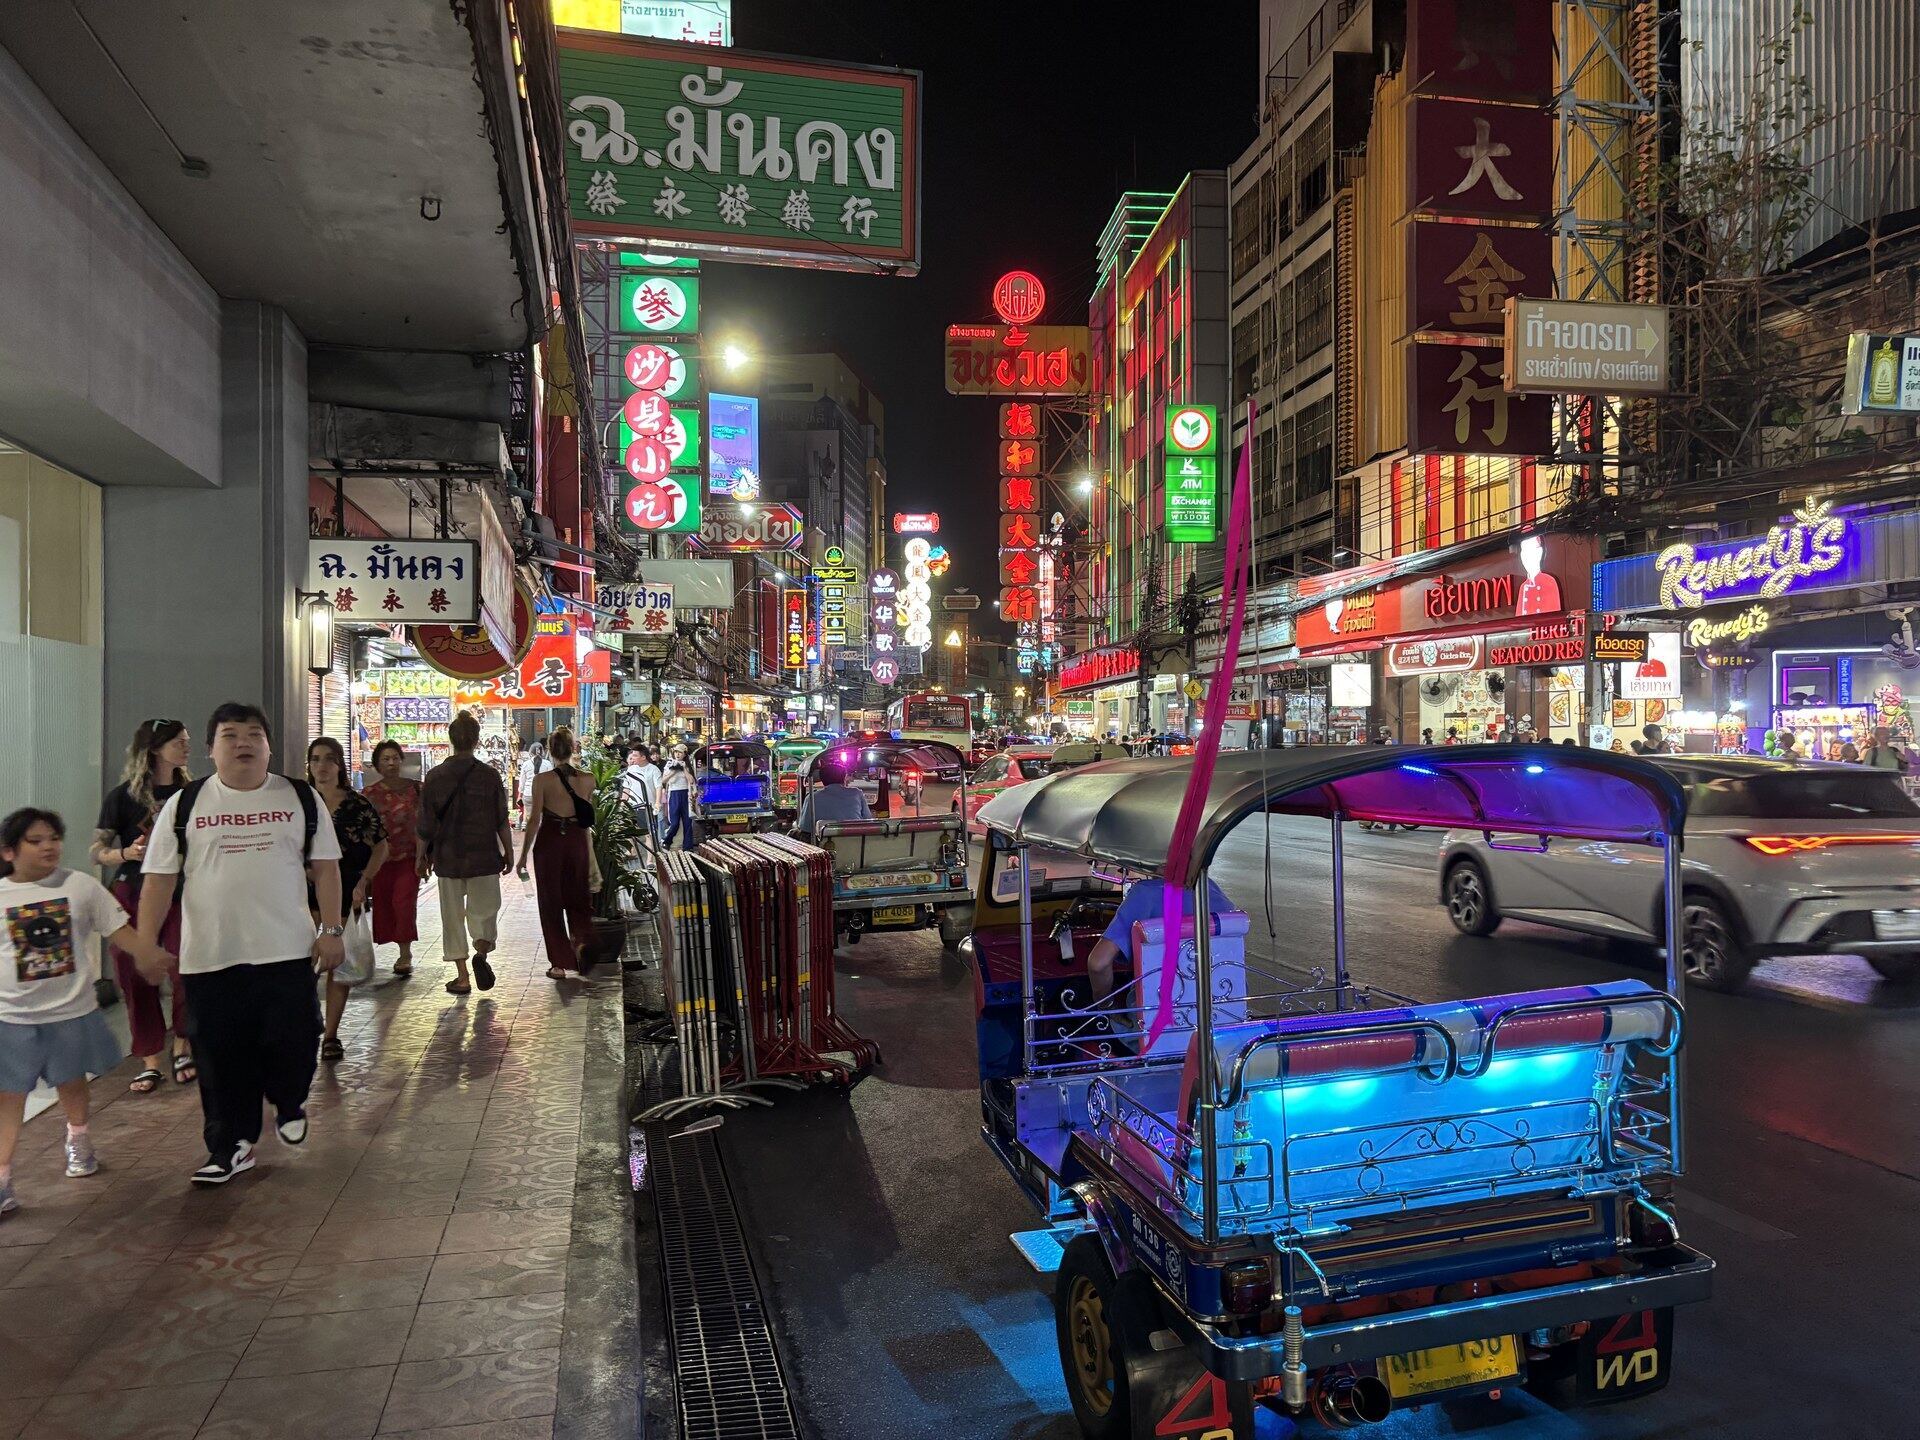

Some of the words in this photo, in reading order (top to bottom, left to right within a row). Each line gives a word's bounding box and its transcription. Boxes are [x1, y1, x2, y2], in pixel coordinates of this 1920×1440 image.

[1526, 307, 1632, 352] ที่จอดรถ
[631, 350, 667, 521] 沙县小吃
[1180, 479, 1202, 489] ATM
[1171, 495, 1212, 506] EXCHANGE
[875, 605, 894, 680] 华歌尔
[1595, 632, 1645, 650] ที่จอดรถ
[1490, 643, 1554, 666] SEAFOOD
[1716, 656, 1743, 666] OPEN
[195, 811, 295, 829] BURBERRY
[1596, 1347, 1659, 1390] WD
[1154, 1369, 1233, 1437] 4
